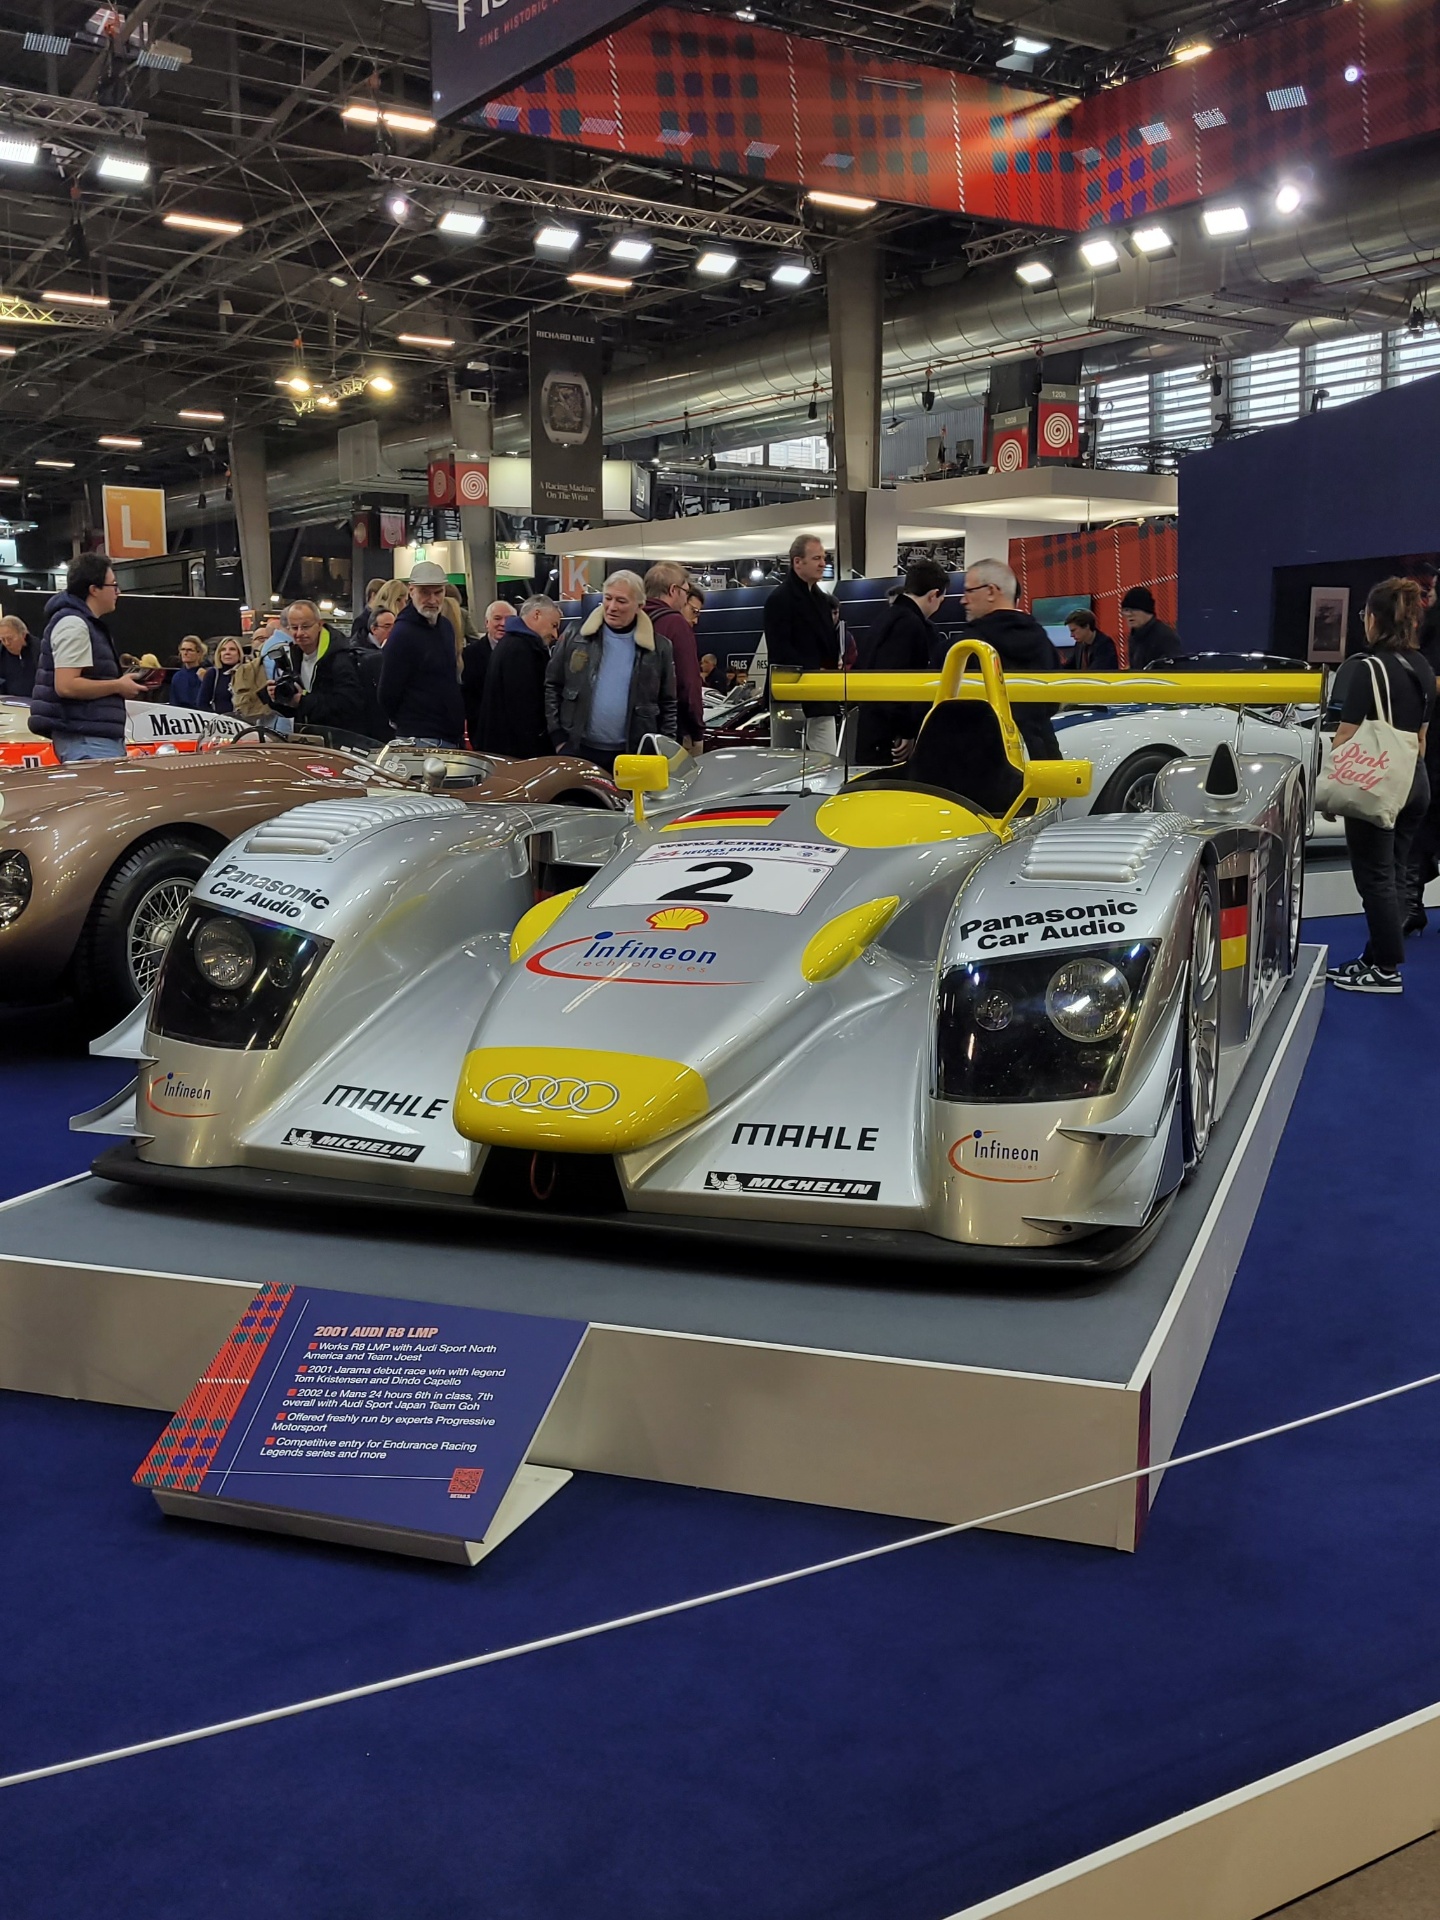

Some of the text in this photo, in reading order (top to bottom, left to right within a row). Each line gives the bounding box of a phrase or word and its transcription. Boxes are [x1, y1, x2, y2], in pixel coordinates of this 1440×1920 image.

[479, 27, 500, 47] FINE
[503, 0, 548, 34] HISTORIC
[536, 330, 596, 344] RICHARD MILLE
[1051, 391, 1067, 399] 1208
[545, 481, 569, 492] Racing
[568, 484, 596, 493] Machine
[546, 491, 589, 502] On The Wrist
[121, 504, 151, 549] L
[568, 557, 589, 593] K
[1332, 742, 1390, 770] Pink
[1327, 760, 1384, 791] Lady
[648, 850, 680, 859] 24
[682, 847, 727, 855] HEURES
[213, 864, 330, 910] Panasonic
[656, 860, 754, 903] 2
[209, 882, 302, 918] Car Audio
[960, 899, 1138, 942] Panasonic
[977, 920, 1126, 950] Car Audio
[582, 933, 718, 965] Infineon
[164, 1077, 211, 1100] Infineon
[321, 1083, 450, 1120] MAHLE
[315, 1134, 418, 1158] MICHELIN
[731, 1122, 880, 1152] MAHLE
[974, 1136, 1039, 1162] Infineon
[746, 1177, 873, 1196] MICHELIN
[314, 1326, 438, 1339] 2001 AUDI R8 LMP
[303, 1351, 422, 1361] America and Team Joest
[319, 1342, 349, 1350] Works
[350, 1343, 366, 1351] R8
[367, 1343, 391, 1351] LMP
[413, 1344, 438, 1352] Audi
[439, 1344, 467, 1354] Sport
[468, 1345, 497, 1353] North
[295, 1374, 461, 1387] Tom Kristensen and Dindo Capello
[307, 1365, 333, 1373] 2001
[334, 1366, 371, 1374] Jarama
[373, 1366, 403, 1375] debut
[429, 1367, 446, 1375] win
[448, 1368, 469, 1376] with
[471, 1368, 506, 1378] legend
[282, 1399, 480, 1410] overall with Audi Sport Japan Team Goh
[297, 1389, 493, 1403] 2002 Le Mans 24 hours 6th in class, 7th
[271, 1422, 328, 1433] Motorsport
[287, 1412, 325, 1422] Offered
[326, 1413, 360, 1424] freshly
[380, 1415, 394, 1425] by
[395, 1416, 434, 1425] experts
[435, 1416, 495, 1427] Progressive
[260, 1447, 304, 1458] Legends
[305, 1449, 336, 1457] series
[337, 1450, 359, 1458] and
[276, 1437, 477, 1453] Competitive entry for Endurance Racing
